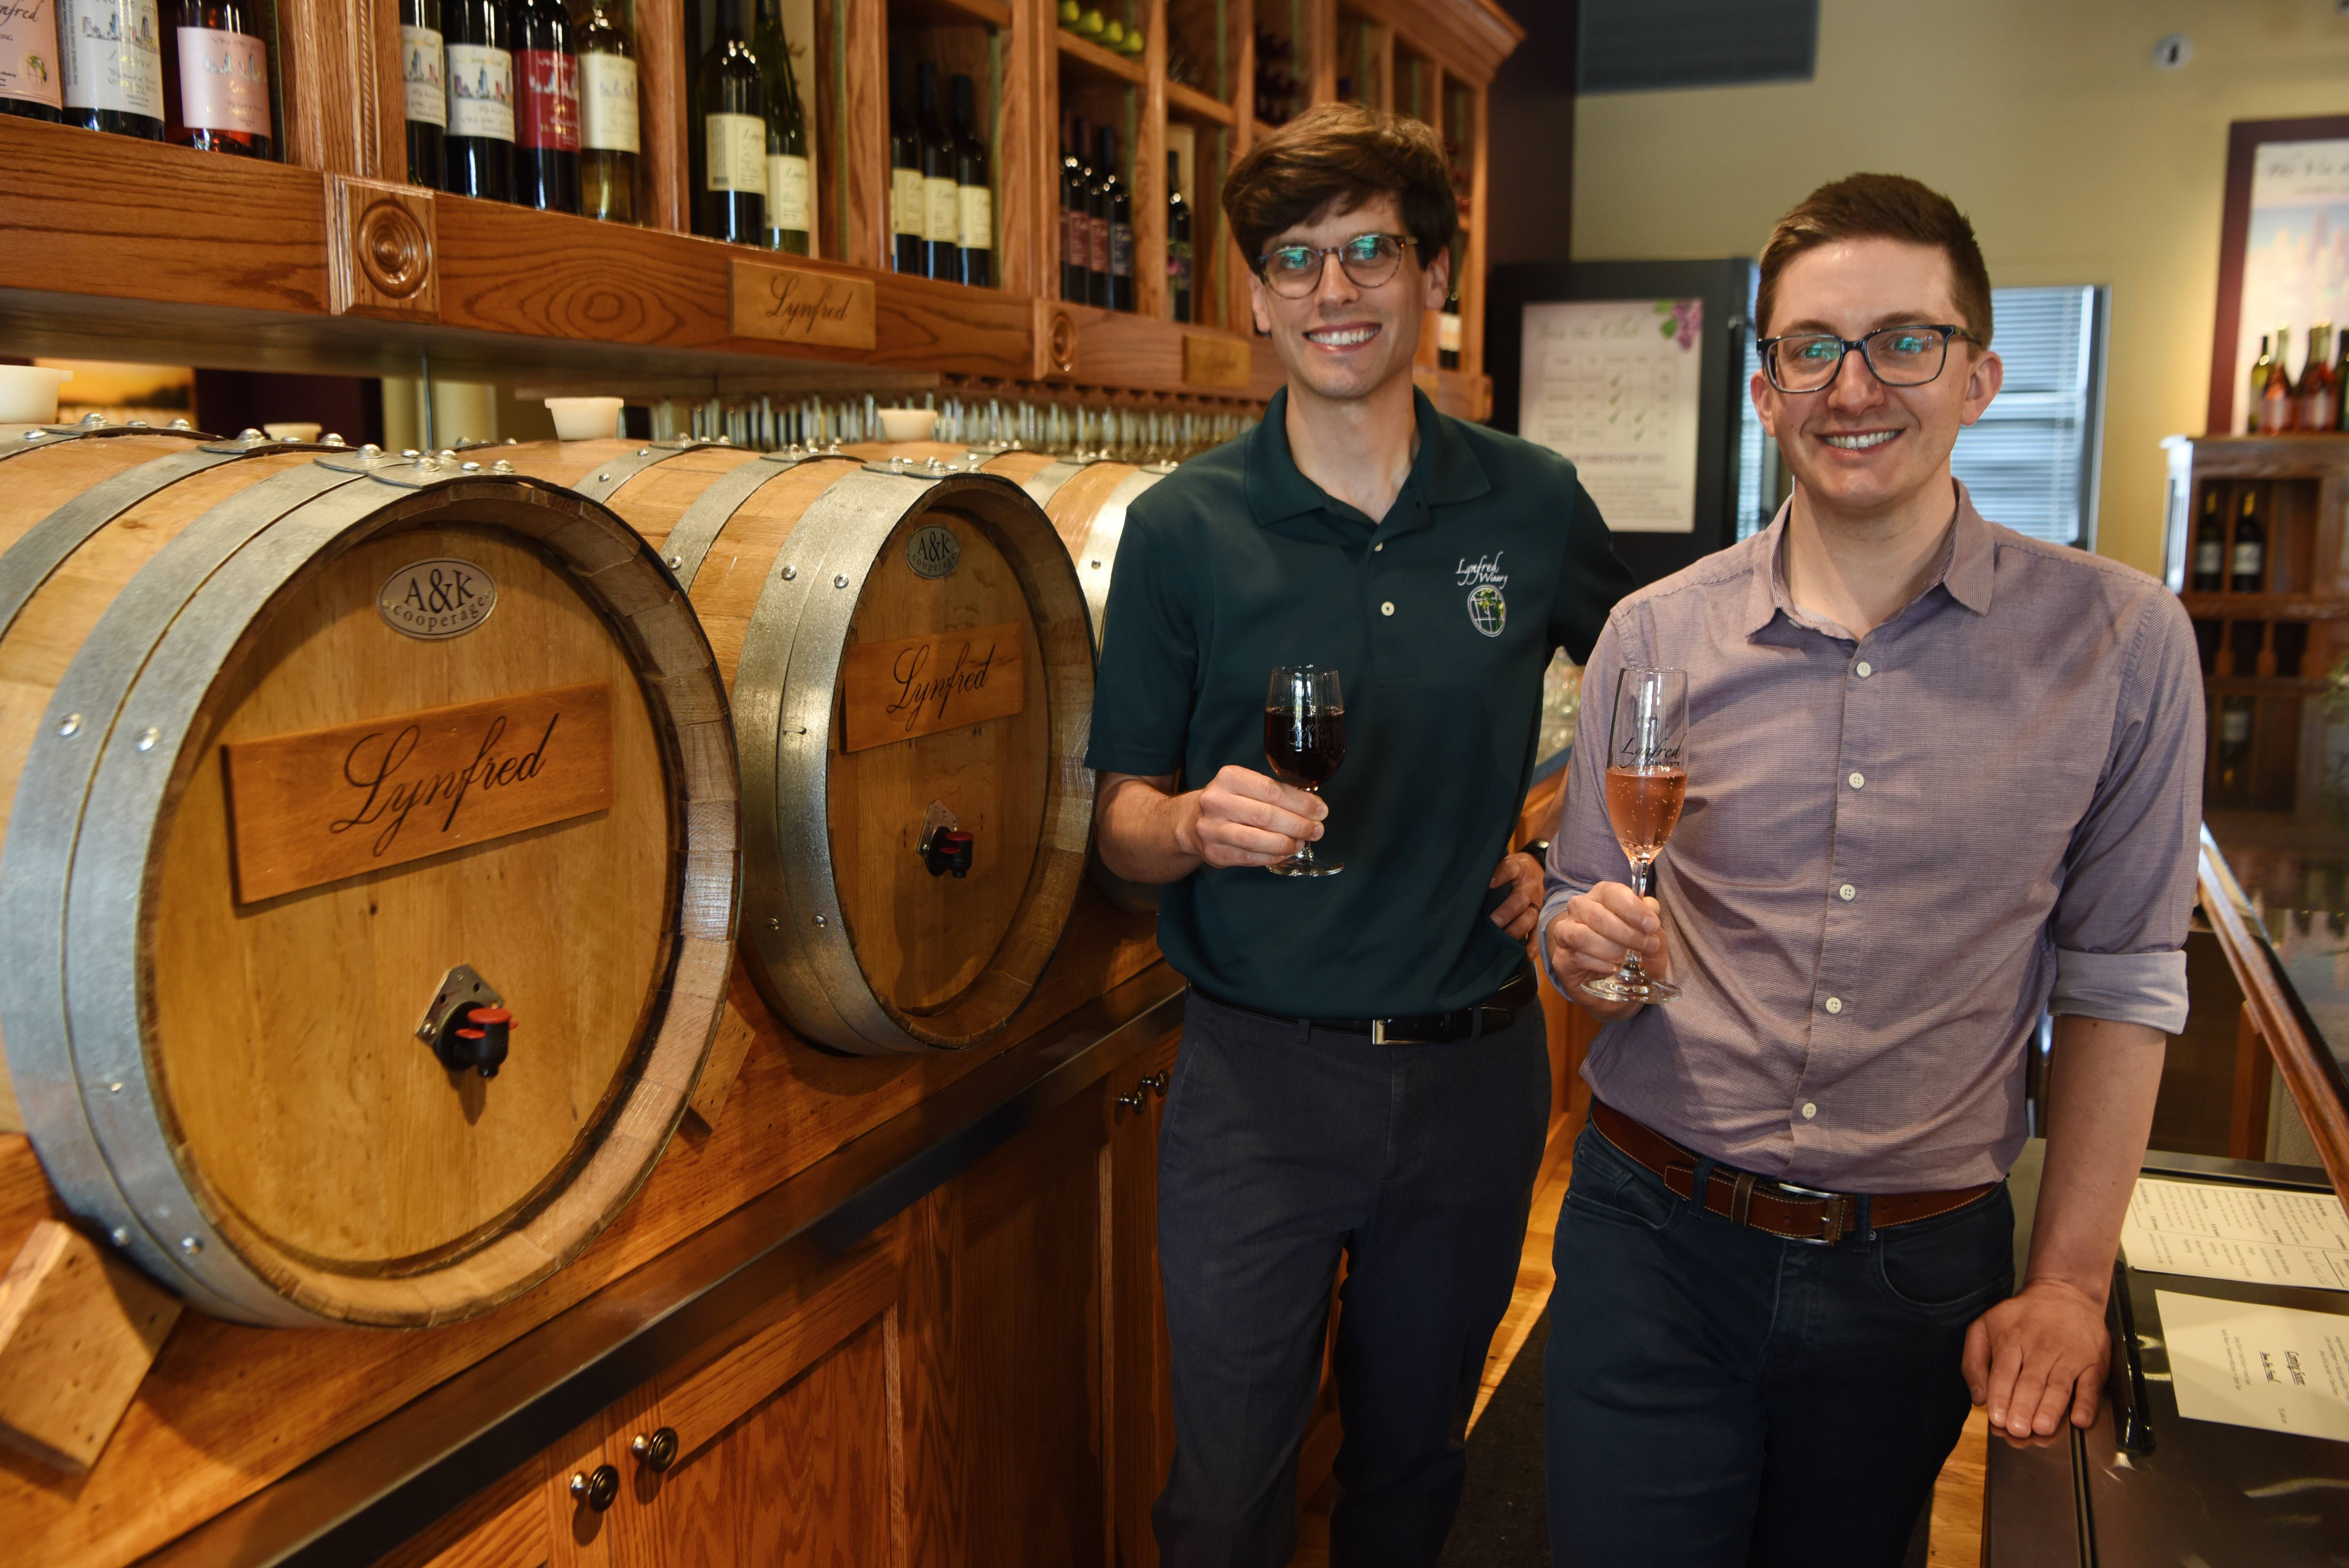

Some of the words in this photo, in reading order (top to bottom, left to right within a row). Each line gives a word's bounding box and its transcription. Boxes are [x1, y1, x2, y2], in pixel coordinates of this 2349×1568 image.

[764, 275, 853, 335] Lynfred
[913, 553, 955, 574] cooperage
[918, 531, 950, 562] A&K
[1455, 551, 1503, 586] Lynfred
[1479, 572, 1508, 590] Winery
[404, 568, 476, 614] A&K
[393, 597, 485, 632] cooperage
[886, 643, 996, 732] Lynfred
[1620, 733, 1687, 768] Lynfred
[330, 713, 560, 857] Lynfred
[2287, 1351, 2301, 1370] Coming
